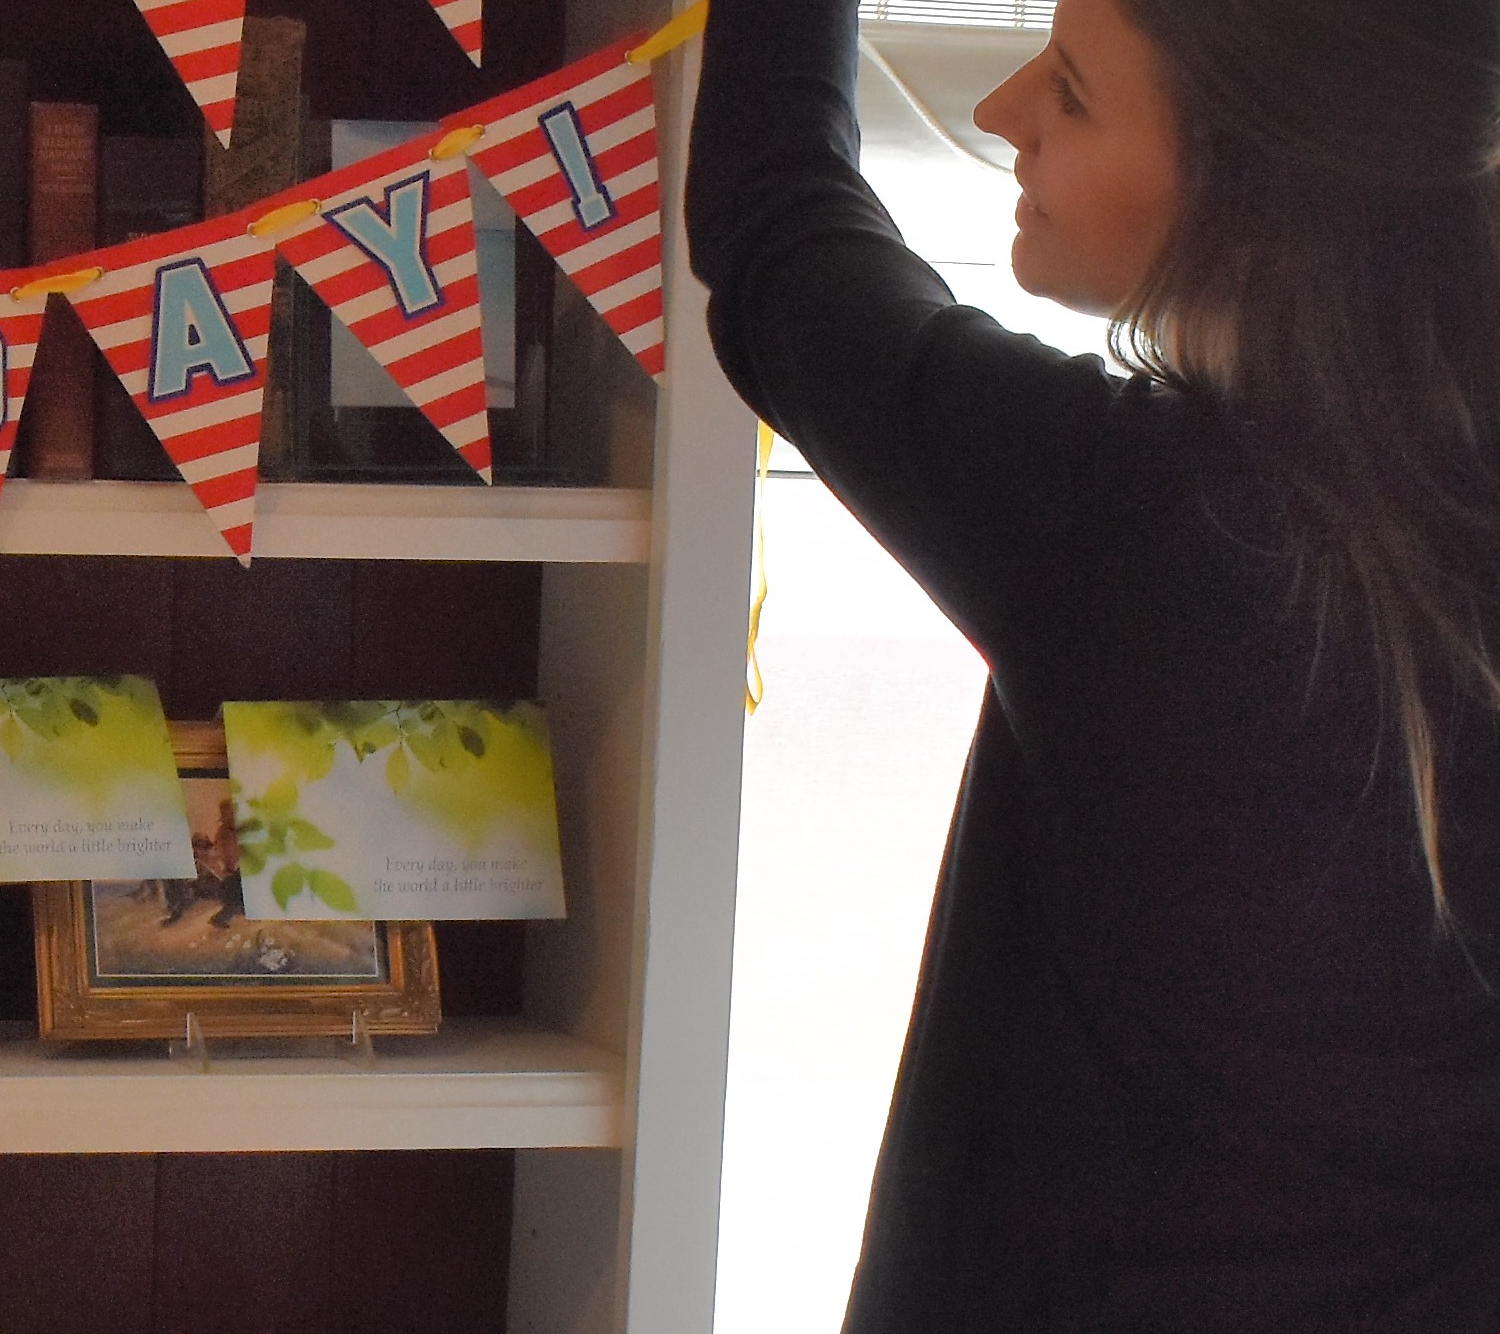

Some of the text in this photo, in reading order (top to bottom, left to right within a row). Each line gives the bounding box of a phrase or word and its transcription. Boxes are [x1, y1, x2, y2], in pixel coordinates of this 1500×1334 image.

[8, 819, 48, 837] Every
[87, 822, 112, 835] you
[114, 816, 153, 831] make
[24, 839, 64, 853] world
[81, 838, 112, 852] little
[117, 837, 171, 856] brighter
